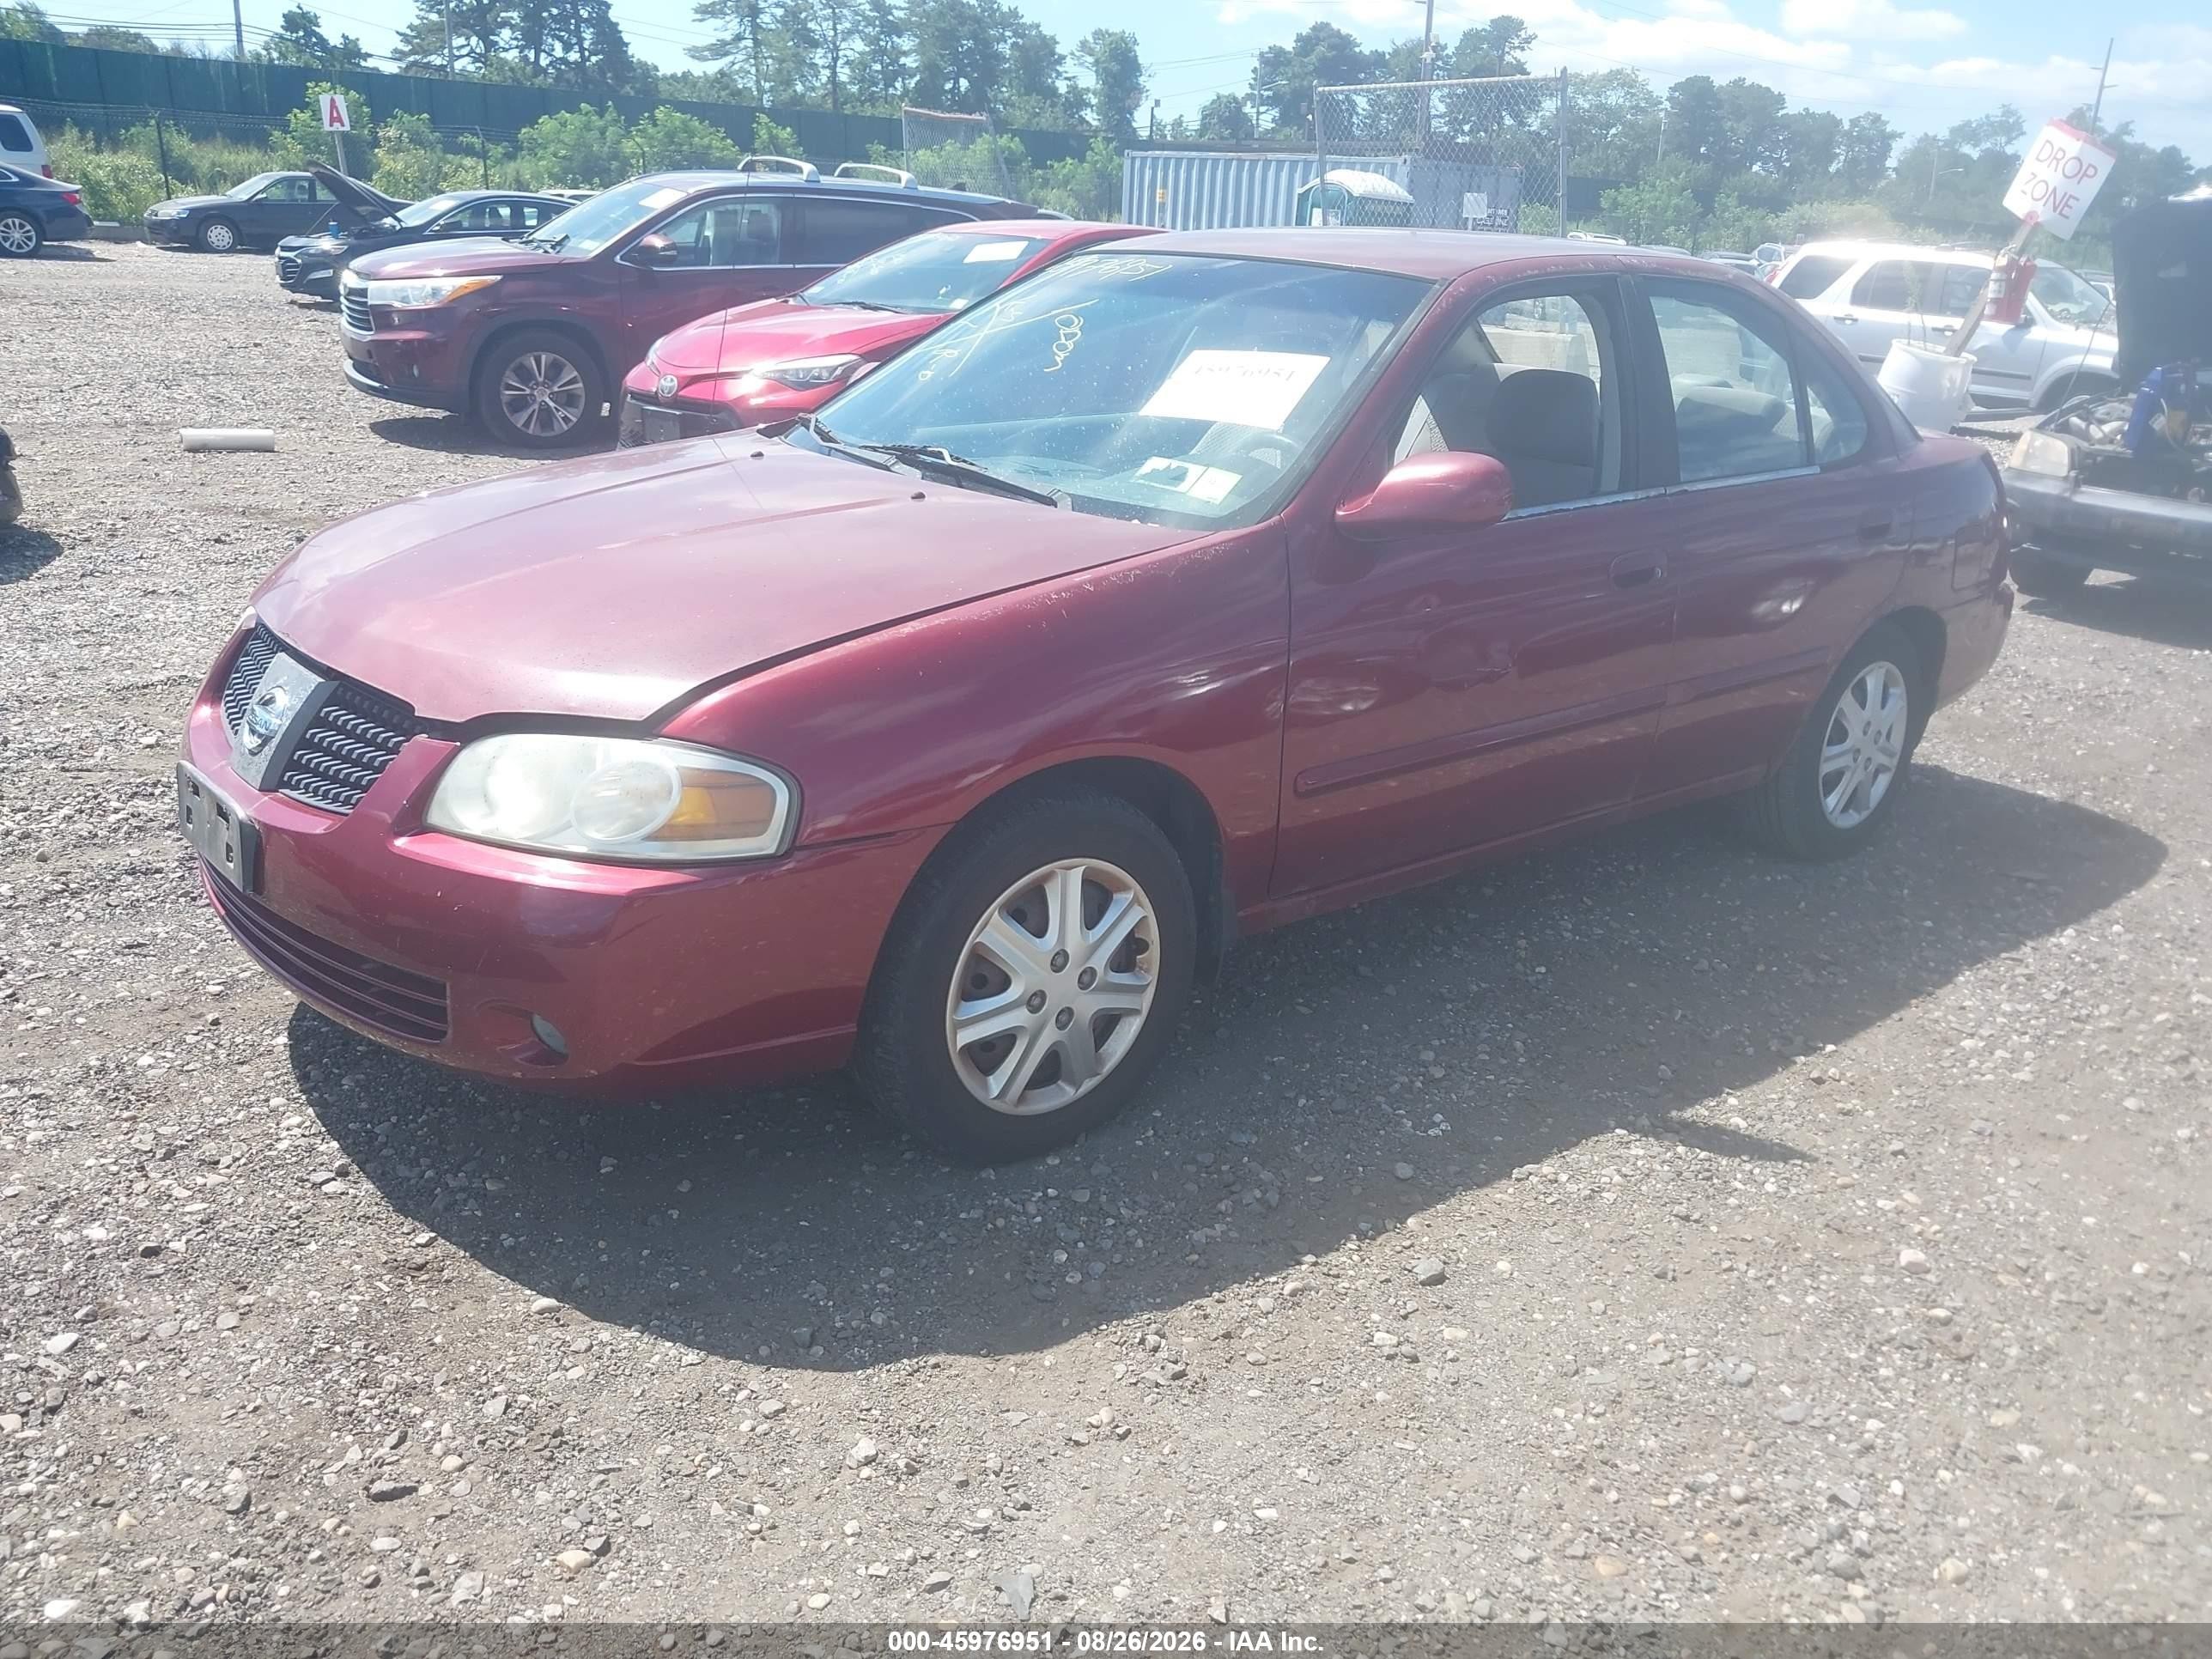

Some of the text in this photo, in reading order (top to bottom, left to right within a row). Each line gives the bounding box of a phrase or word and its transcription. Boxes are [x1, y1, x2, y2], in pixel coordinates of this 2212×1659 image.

[329, 95, 344, 127] A
[2035, 139, 2099, 185] DROP
[2021, 171, 2081, 220] ZONE
